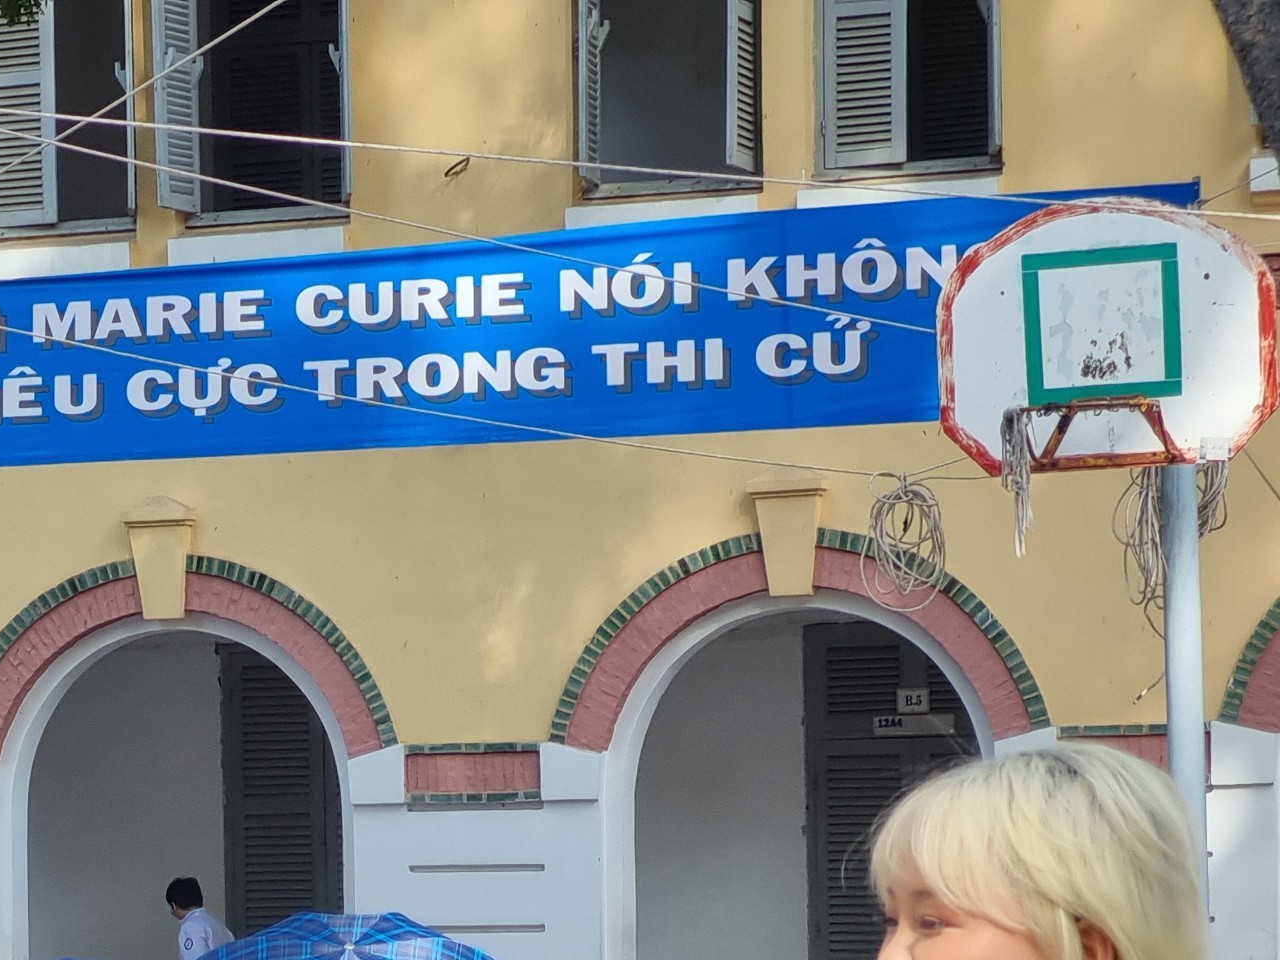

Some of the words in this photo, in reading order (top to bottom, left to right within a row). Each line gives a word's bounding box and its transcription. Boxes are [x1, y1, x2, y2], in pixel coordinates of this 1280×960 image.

[31, 288, 266, 344] MARIE
[295, 271, 525, 328] CURIE
[559, 251, 693, 313] NÓI
[726, 237, 972, 302] KHÔN
[125, 356, 279, 417] CỰC
[302, 346, 566, 402] TRONG
[590, 337, 724, 387] THI
[755, 312, 873, 378] CỬ
